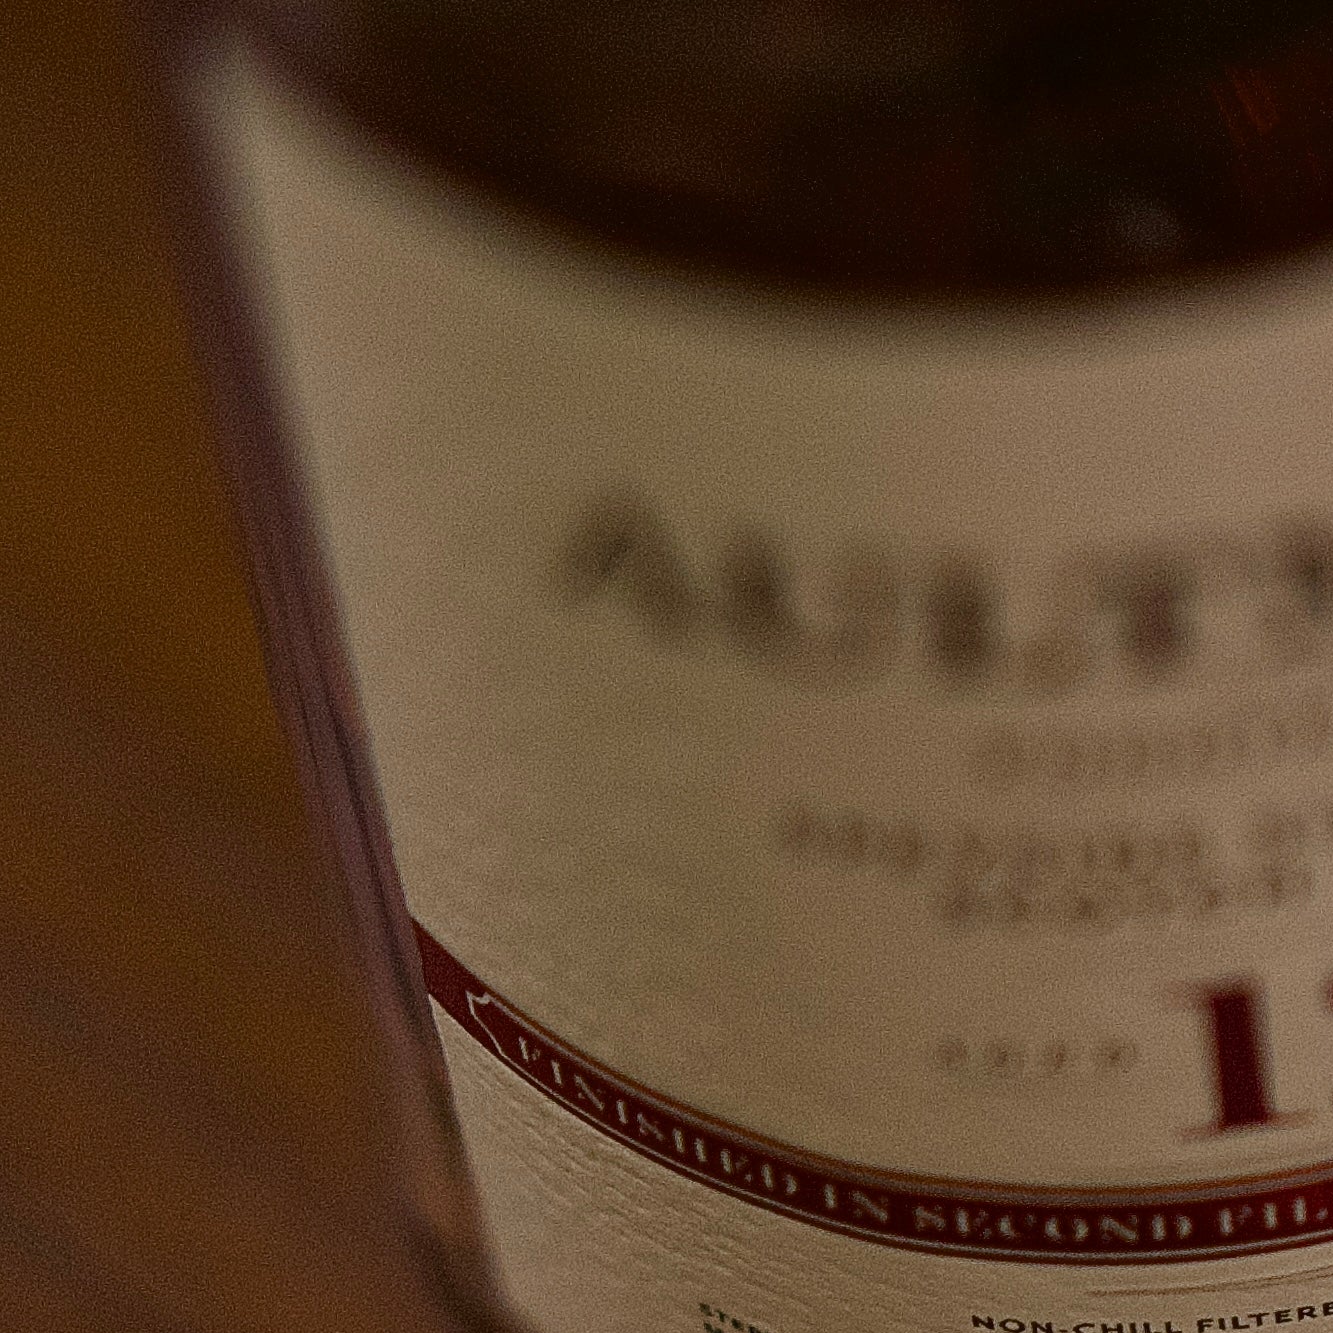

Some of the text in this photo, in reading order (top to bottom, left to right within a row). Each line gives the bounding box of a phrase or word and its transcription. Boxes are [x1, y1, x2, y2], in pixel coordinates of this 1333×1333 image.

[517, 1036, 800, 1196] FINISHED
[824, 1183, 889, 1224] IN
[914, 1205, 1193, 1243] SECOND
